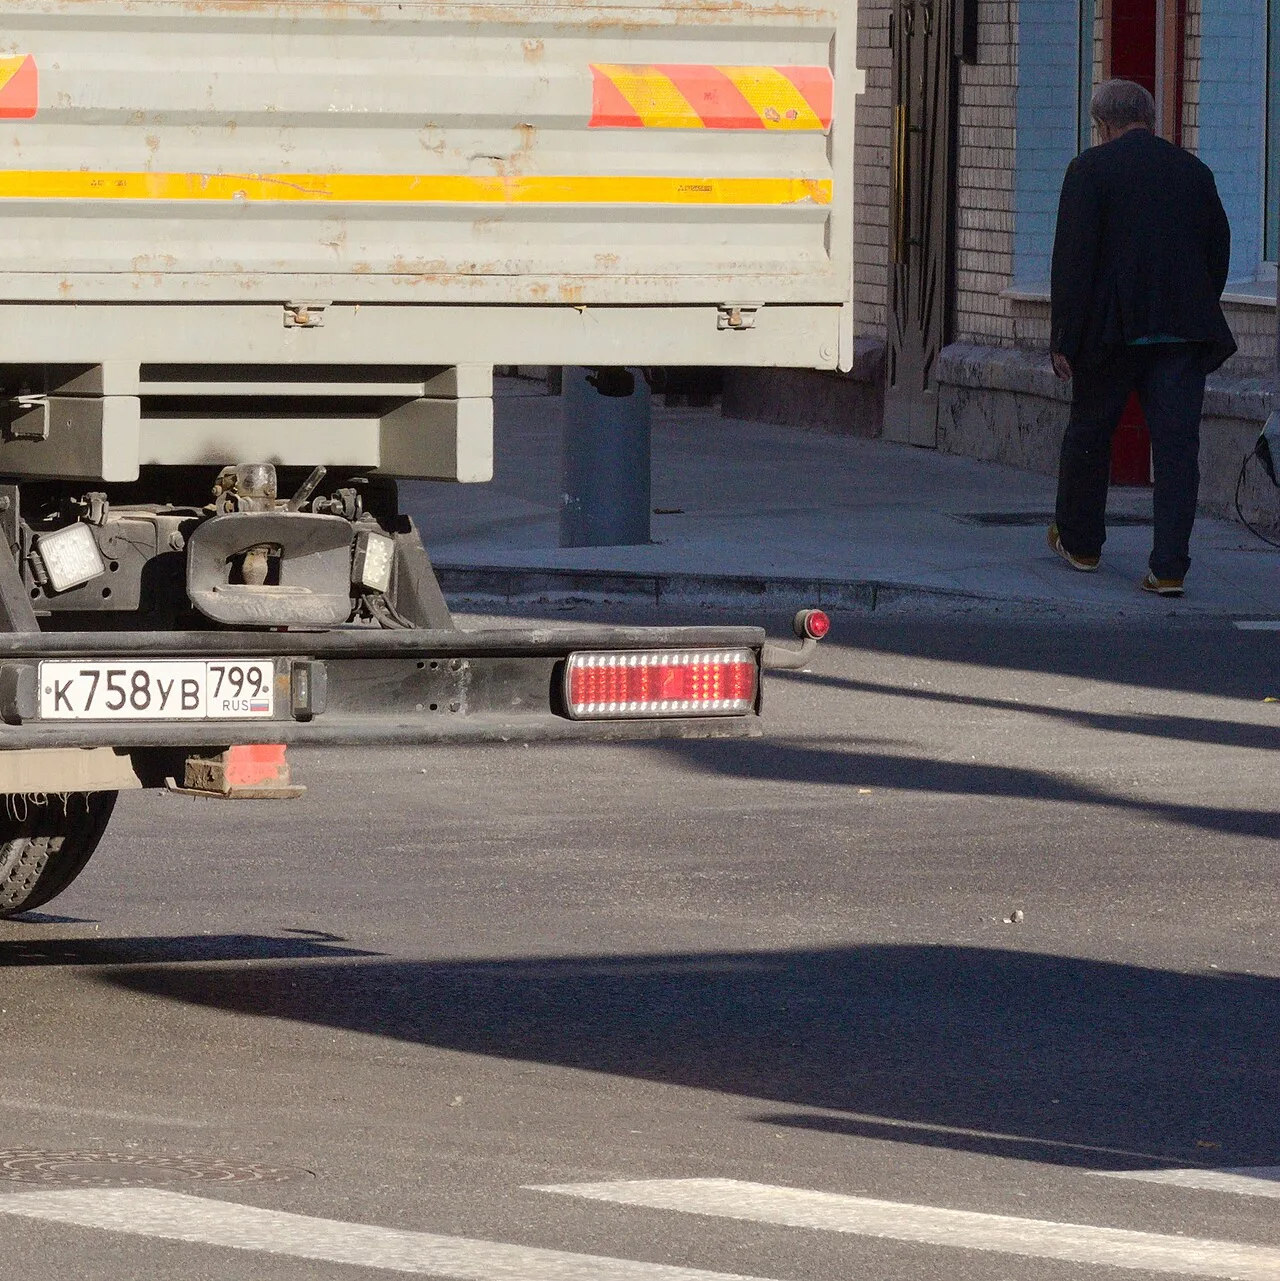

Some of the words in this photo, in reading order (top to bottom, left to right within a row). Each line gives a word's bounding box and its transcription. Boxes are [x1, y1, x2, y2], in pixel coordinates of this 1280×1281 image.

[54, 669, 200, 712] К758УВ
[209, 666, 263, 698] 799
[222, 699, 249, 711] RUS
